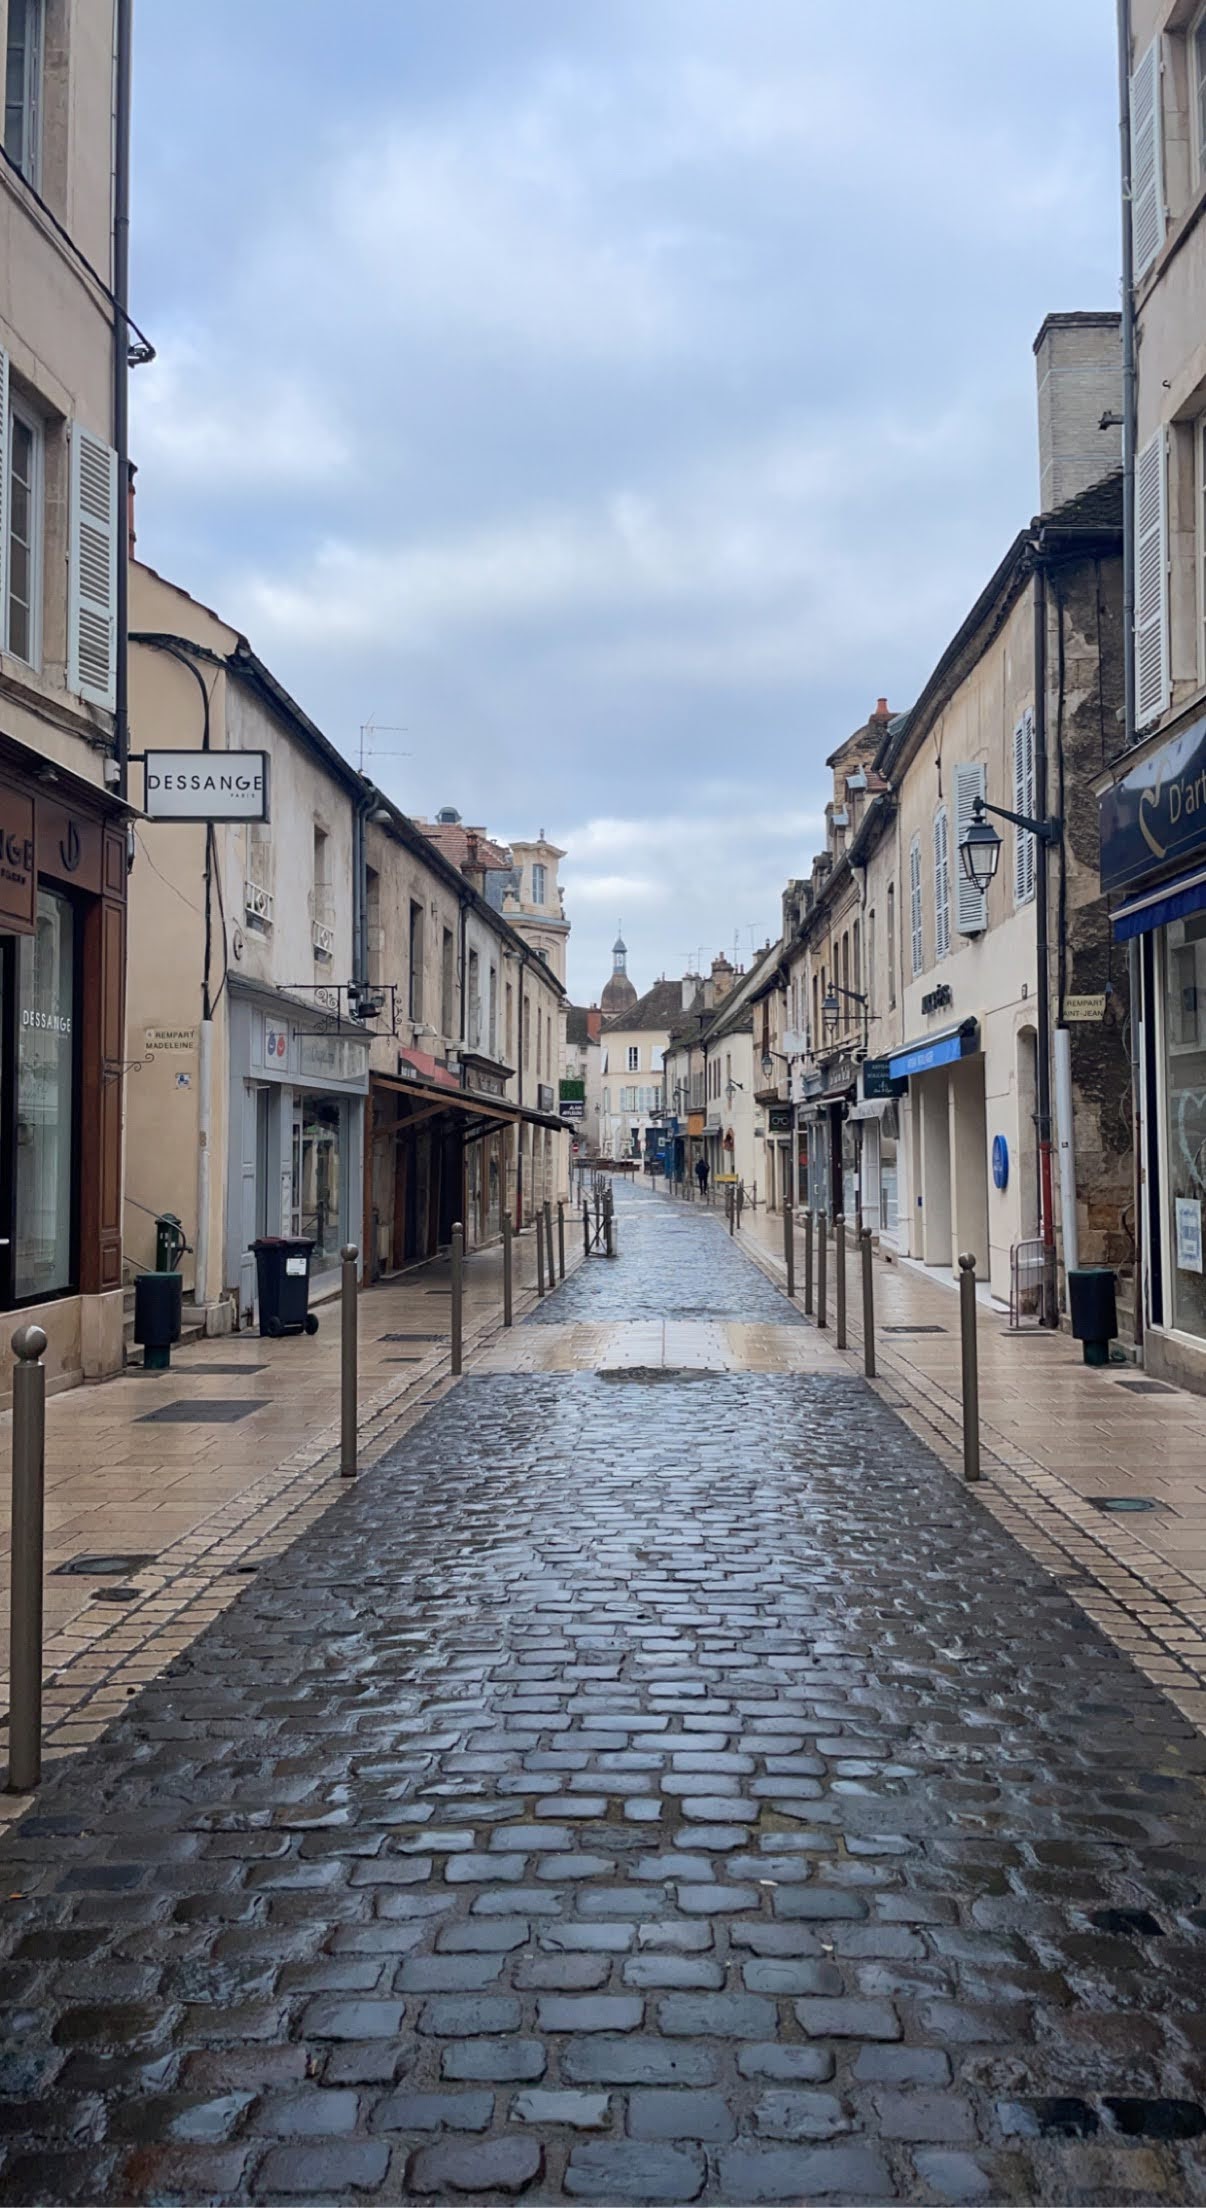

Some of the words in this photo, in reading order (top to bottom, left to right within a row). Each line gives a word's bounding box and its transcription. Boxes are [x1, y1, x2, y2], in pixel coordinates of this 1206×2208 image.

[148, 775, 262, 790] DESSANGE
[1066, 999, 1103, 1008] REMPART
[22, 1009, 72, 1033] DESSANGE
[155, 1030, 194, 1040] REMPART
[145, 1041, 194, 1050] MADELEINE
